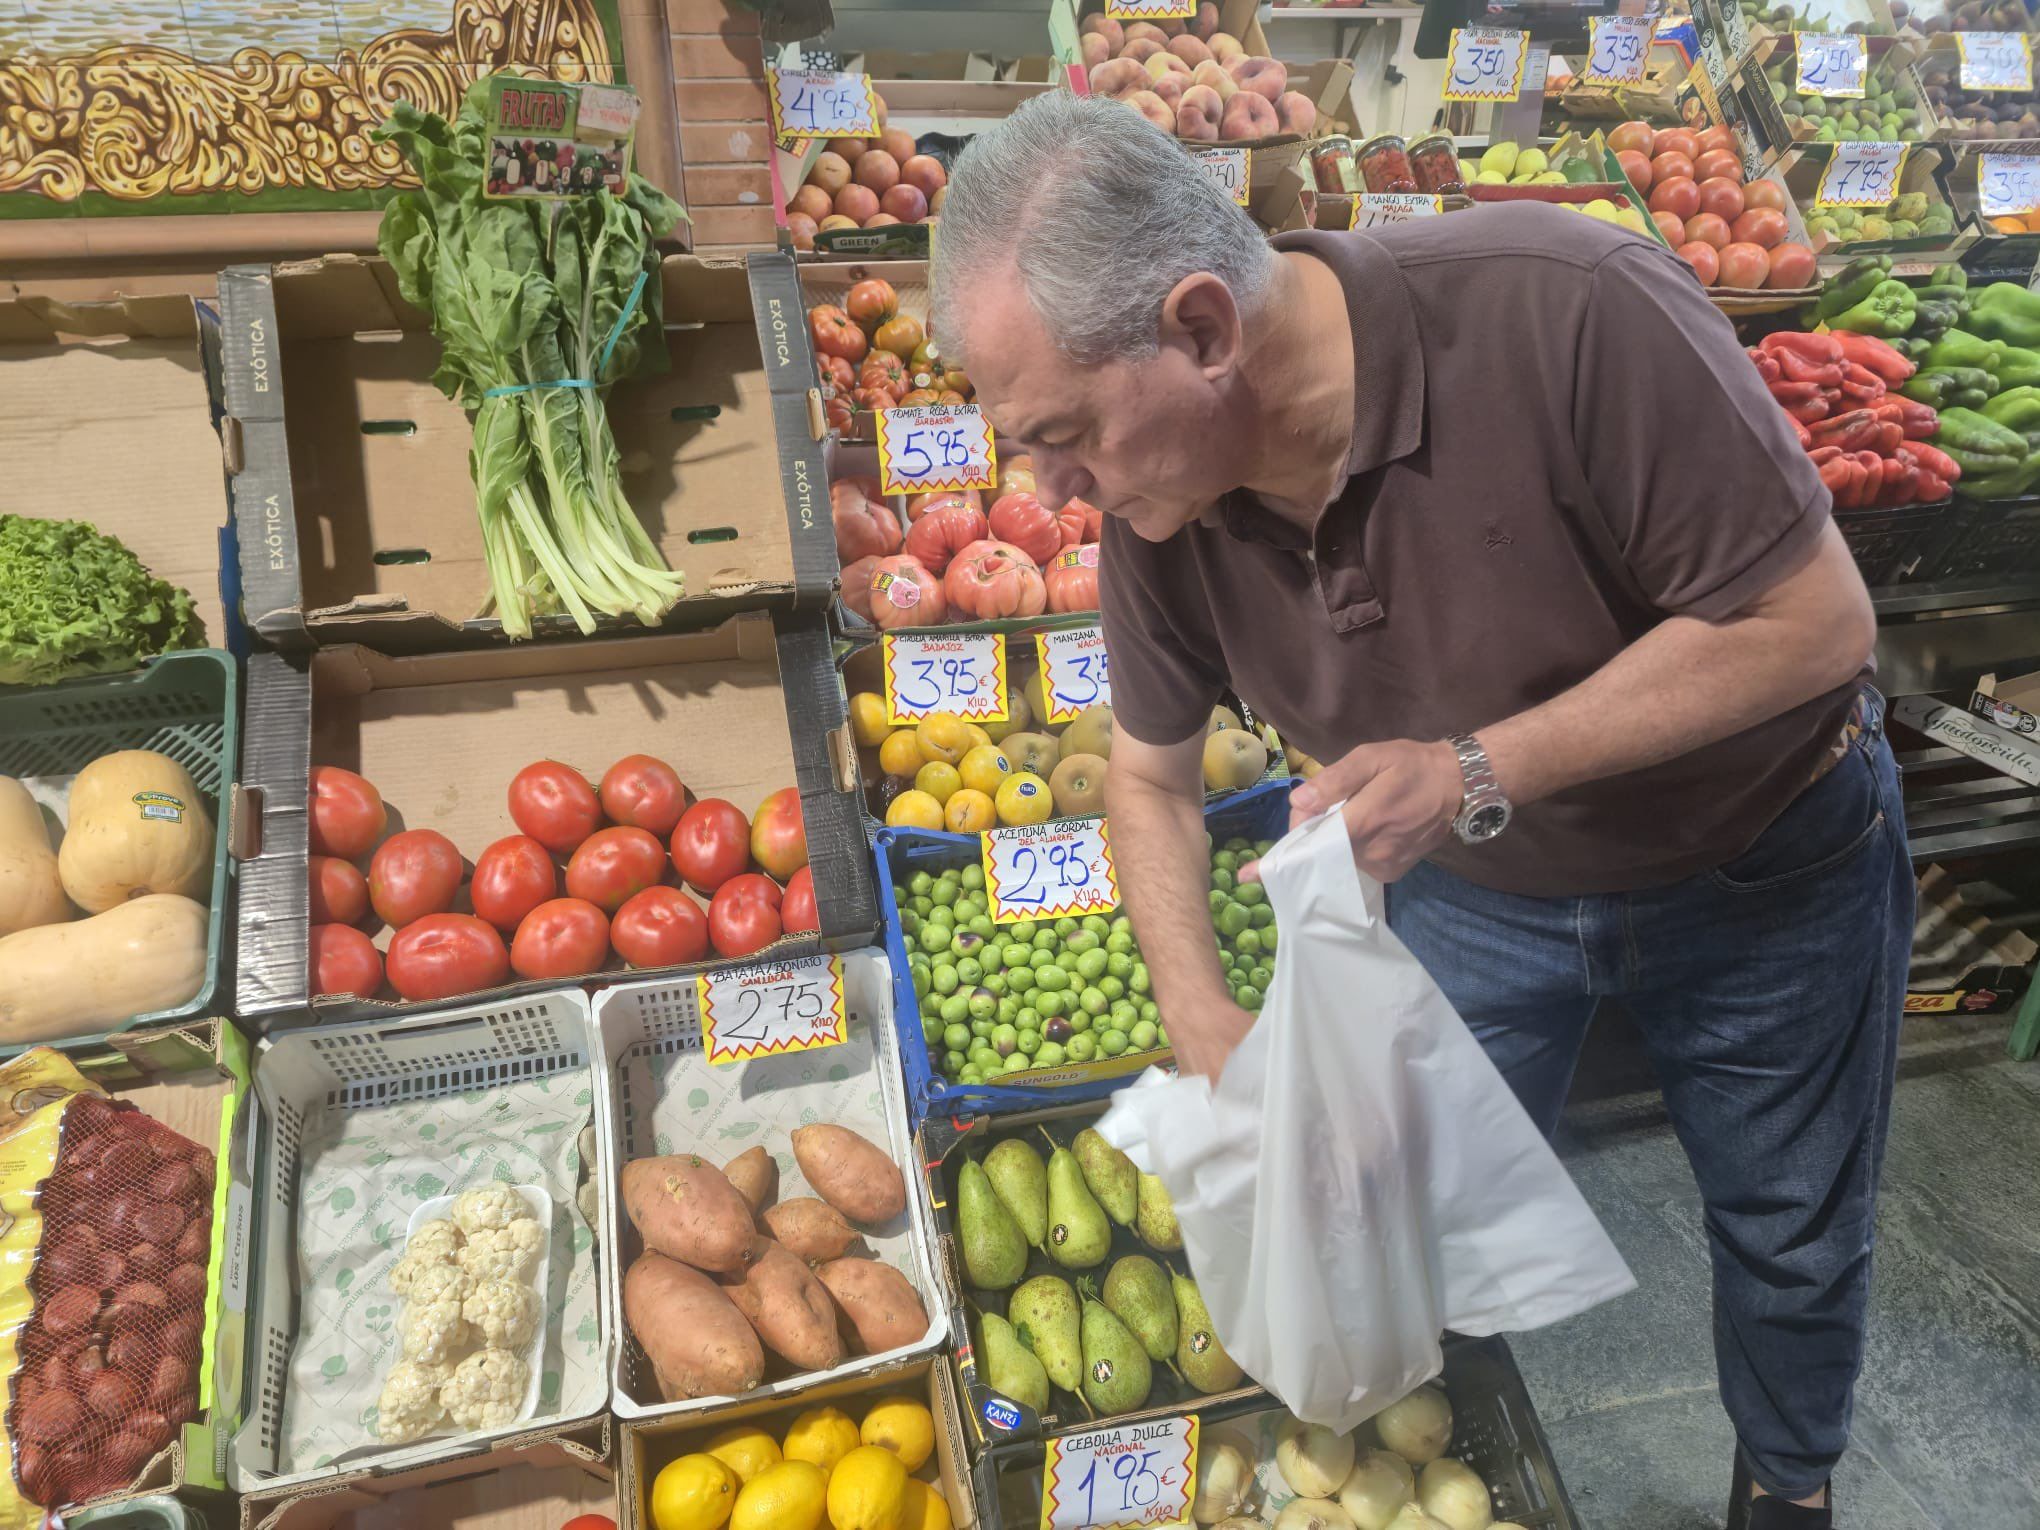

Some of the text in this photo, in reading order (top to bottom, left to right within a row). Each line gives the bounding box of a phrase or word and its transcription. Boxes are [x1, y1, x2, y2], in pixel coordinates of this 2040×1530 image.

[1455, 47, 1504, 85] 3'50
[1592, 35, 1639, 73] 3'50
[501, 89, 566, 130] FRUTAS
[790, 88, 857, 129] 4'95
[1838, 160, 1888, 198] 7'95
[1368, 195, 1430, 205] MANGO EXTRA
[840, 238, 879, 246] GREEN
[769, 299, 791, 367] EXÓTICA
[250, 318, 269, 393] EXÓTICA
[891, 404, 978, 419] TOMATE ROSA EXTRA
[897, 429, 968, 477] 5'95
[962, 466, 979, 477] KILO
[794, 460, 814, 530] EXÓTICA
[265, 494, 285, 570] EXÓTICA
[921, 642, 965, 652] BADAJOZ
[965, 633, 986, 641] EXTRA
[1054, 629, 1096, 643] MANZANA
[900, 657, 978, 708] 3'95
[968, 697, 987, 708] KILO
[998, 821, 1093, 840] ACEITUNA GORDAL
[1000, 841, 1089, 904] 2'95
[1074, 888, 1100, 902] KILO
[721, 982, 823, 1040] 2'75
[811, 1016, 833, 1029] KILO
[1013, 1072, 1079, 1086] SUNGOLD
[1067, 1423, 1173, 1451] CEBOLLA DULCE
[1094, 1441, 1146, 1457] NACIONAL
[1077, 1450, 1160, 1528] 1'95
[1145, 1501, 1172, 1518] KILO
